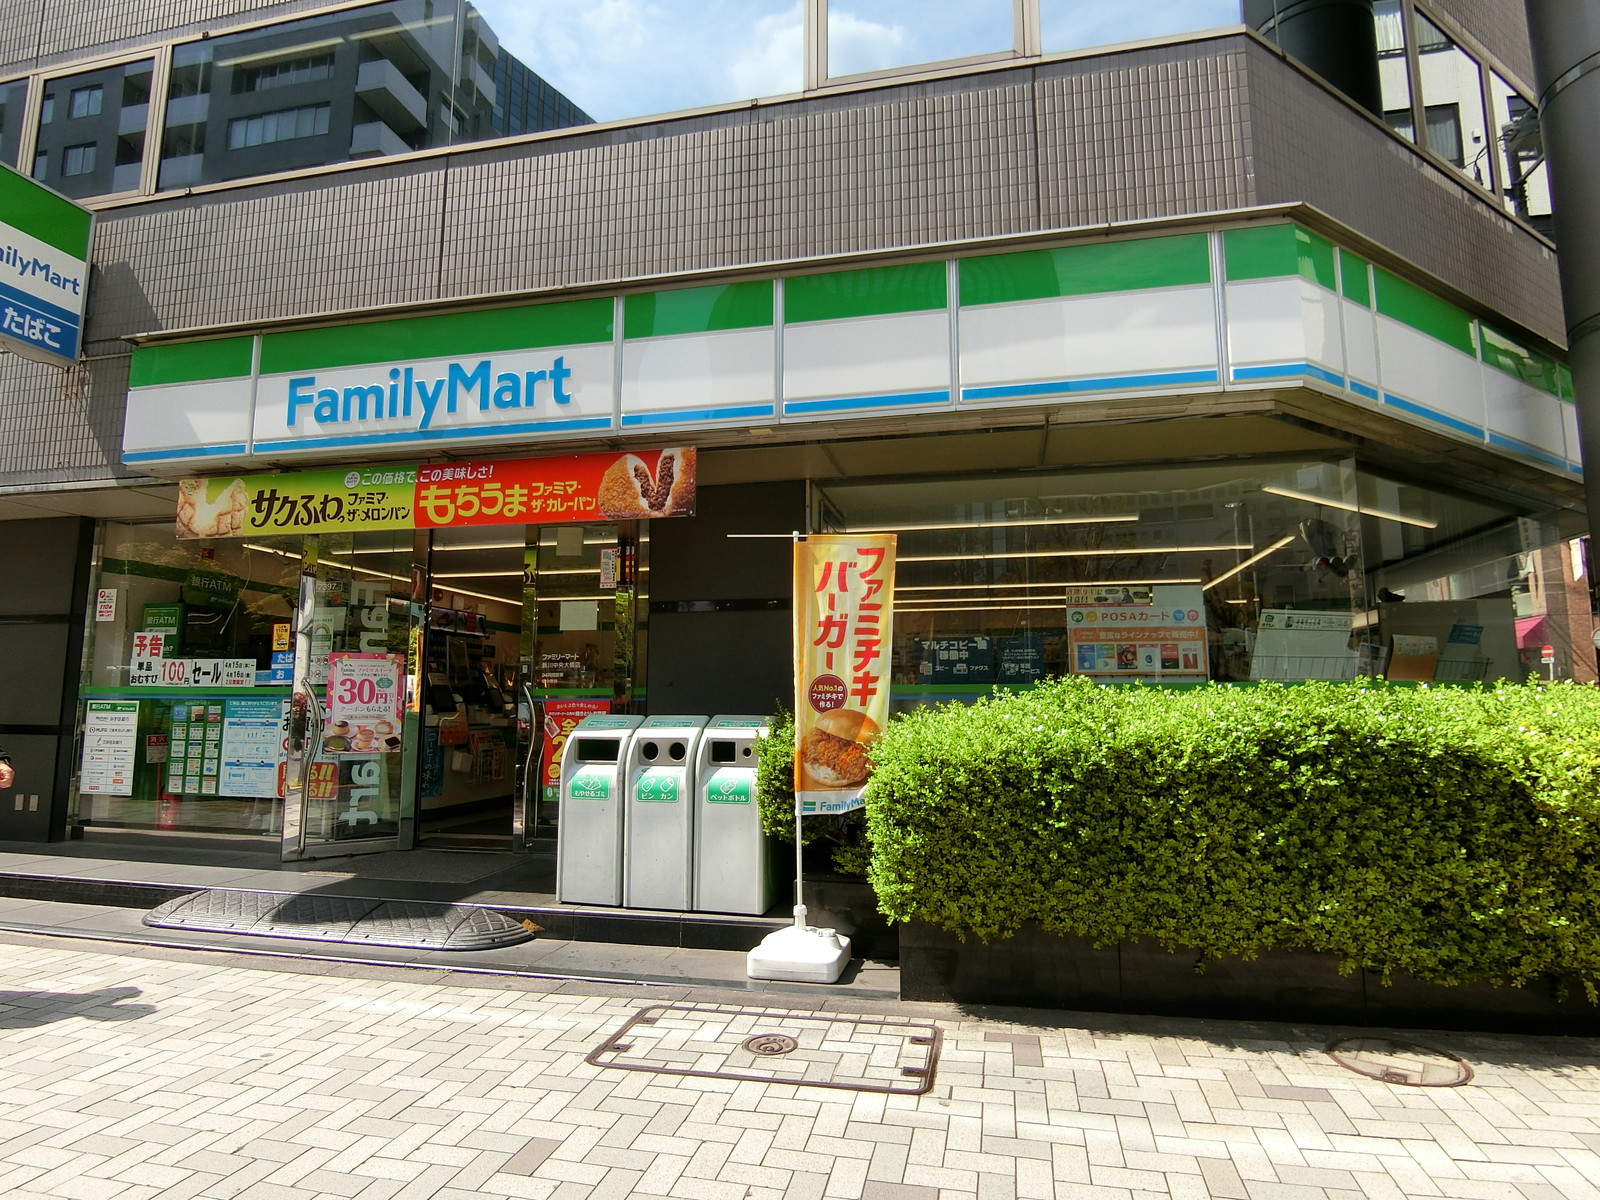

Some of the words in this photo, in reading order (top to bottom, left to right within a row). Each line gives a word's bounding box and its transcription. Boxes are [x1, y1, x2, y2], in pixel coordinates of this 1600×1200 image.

[3, 306, 61, 349] たばこ
[285, 355, 572, 432] FamilyMart
[418, 480, 529, 525] もちうま
[530, 496, 596, 513] ザ・カレーパン
[250, 488, 346, 528] サクふわっ
[346, 506, 411, 523] ザ・メロンパン
[191, 575, 232, 592] 銀行ATM
[146, 615, 176, 625] 銀行ATM
[813, 561, 858, 670] バーガー
[1101, 610, 1170, 622] POSAカード
[850, 547, 886, 707] ファミチキ
[1100, 630, 1199, 640] 豊富なラインナップで販売中!
[134, 634, 164, 658] 予告
[541, 653, 580, 661] ファミリーマート
[939, 650, 969, 660] 稼働中
[136, 661, 153, 671] 単品
[192, 661, 222, 684] セール
[130, 674, 159, 684] おむすび
[812, 684, 844, 692] 人気No.1の
[811, 692, 844, 700] ファミチキで
[339, 705, 391, 713] クーポンもらえる!
[818, 700, 835, 708] 作る!
[574, 790, 606, 798] もやせるゴミ
[641, 792, 655, 800] ビン
[660, 792, 674, 800] カン
[710, 793, 747, 802] ペットボトル
[819, 796, 867, 812] FamilyMa
